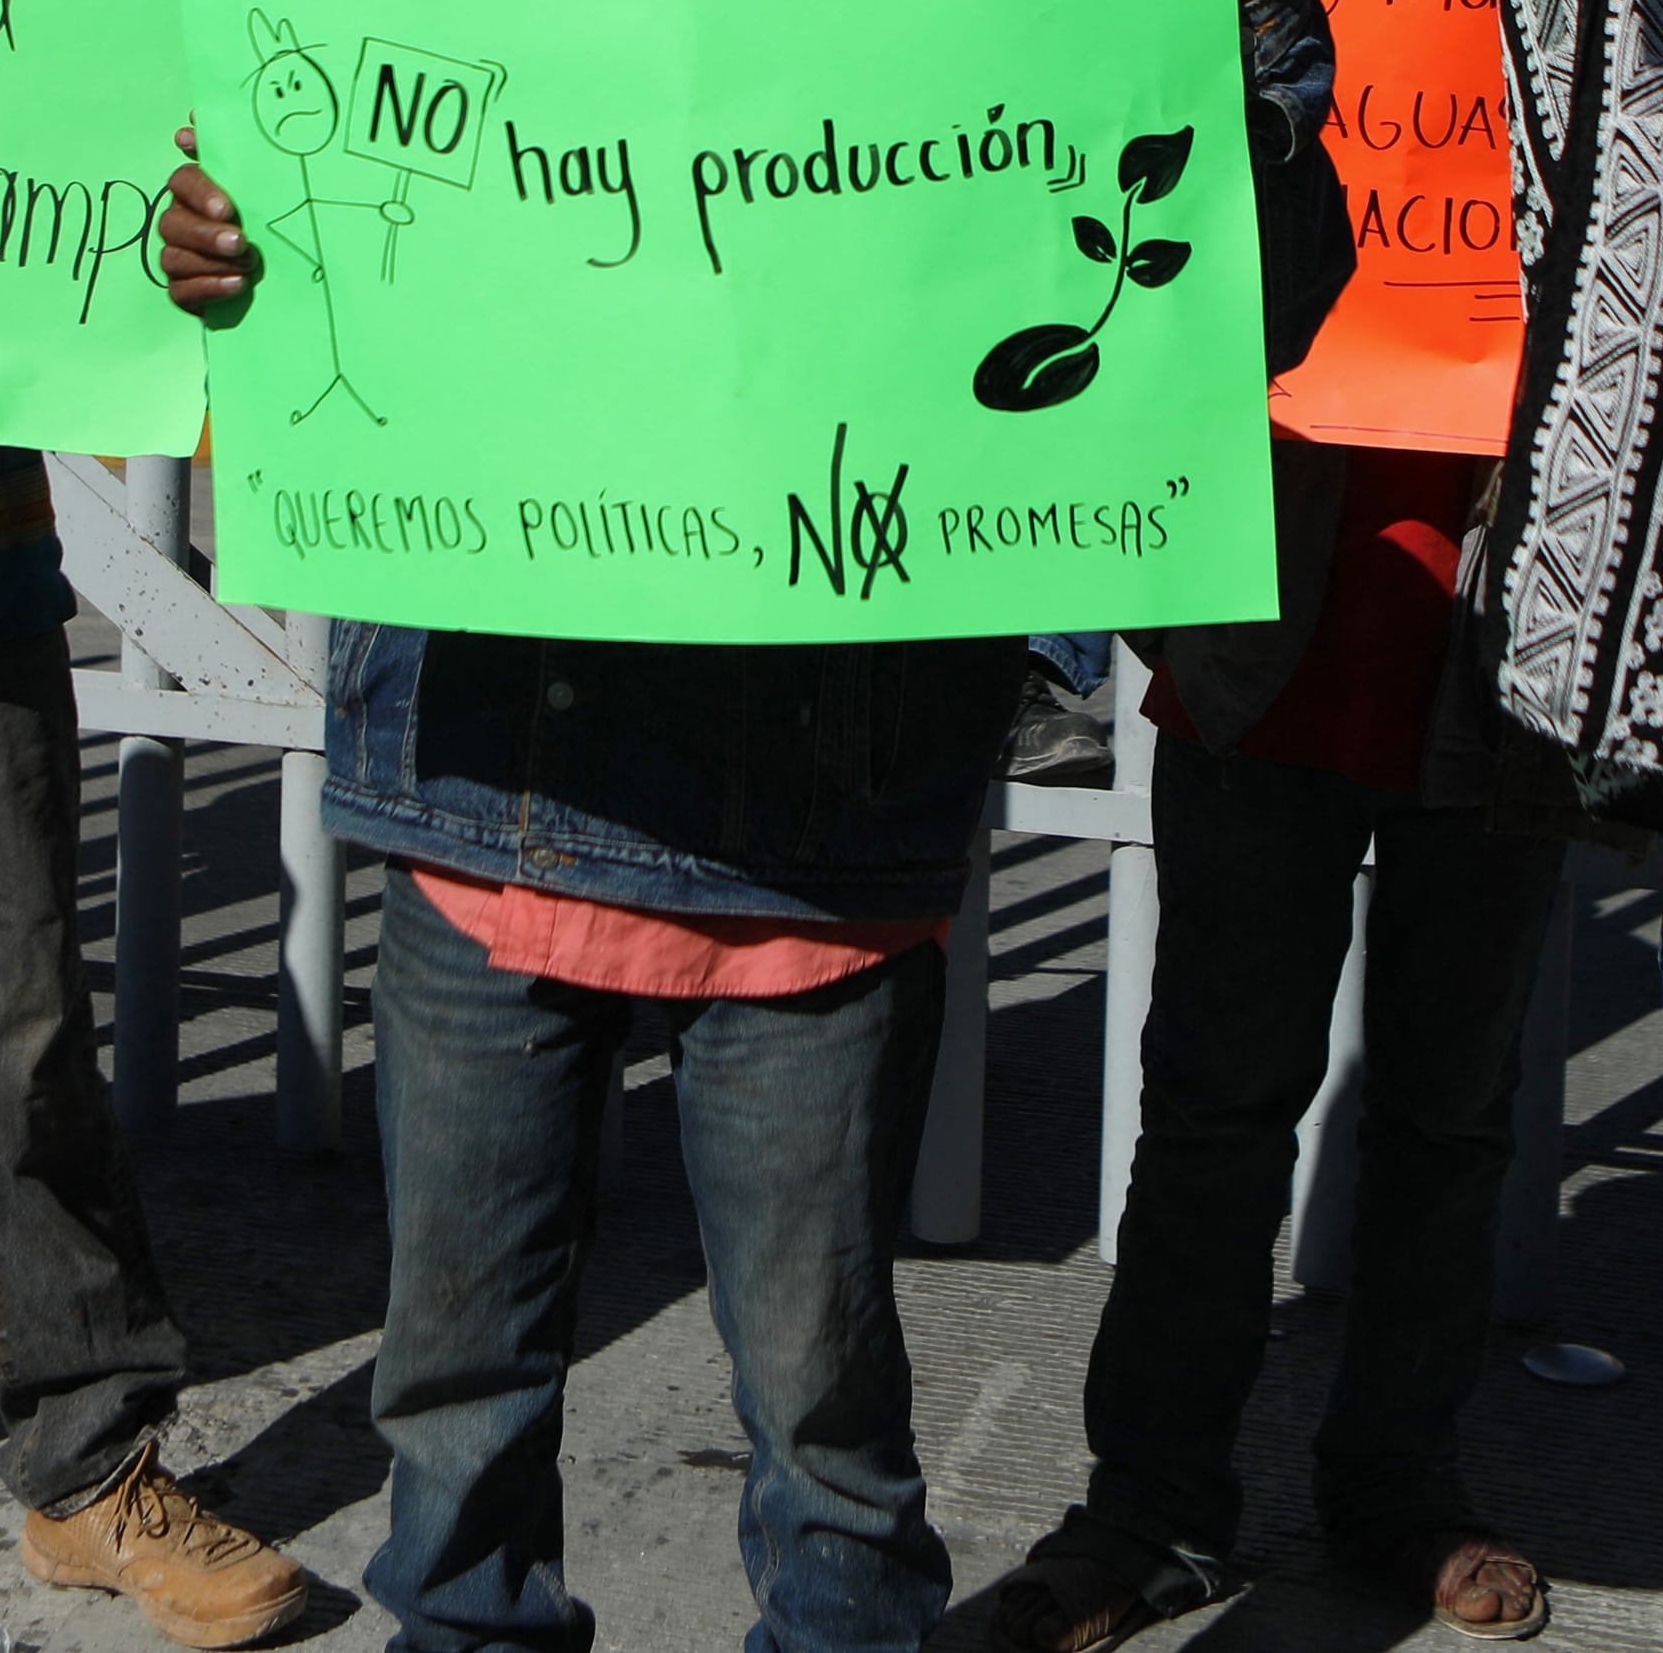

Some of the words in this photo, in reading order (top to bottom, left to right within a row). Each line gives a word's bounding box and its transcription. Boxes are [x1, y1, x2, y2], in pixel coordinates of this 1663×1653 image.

[368, 63, 470, 154] NO
[504, 120, 642, 268] hay
[1340, 184, 1518, 255] ACIO
